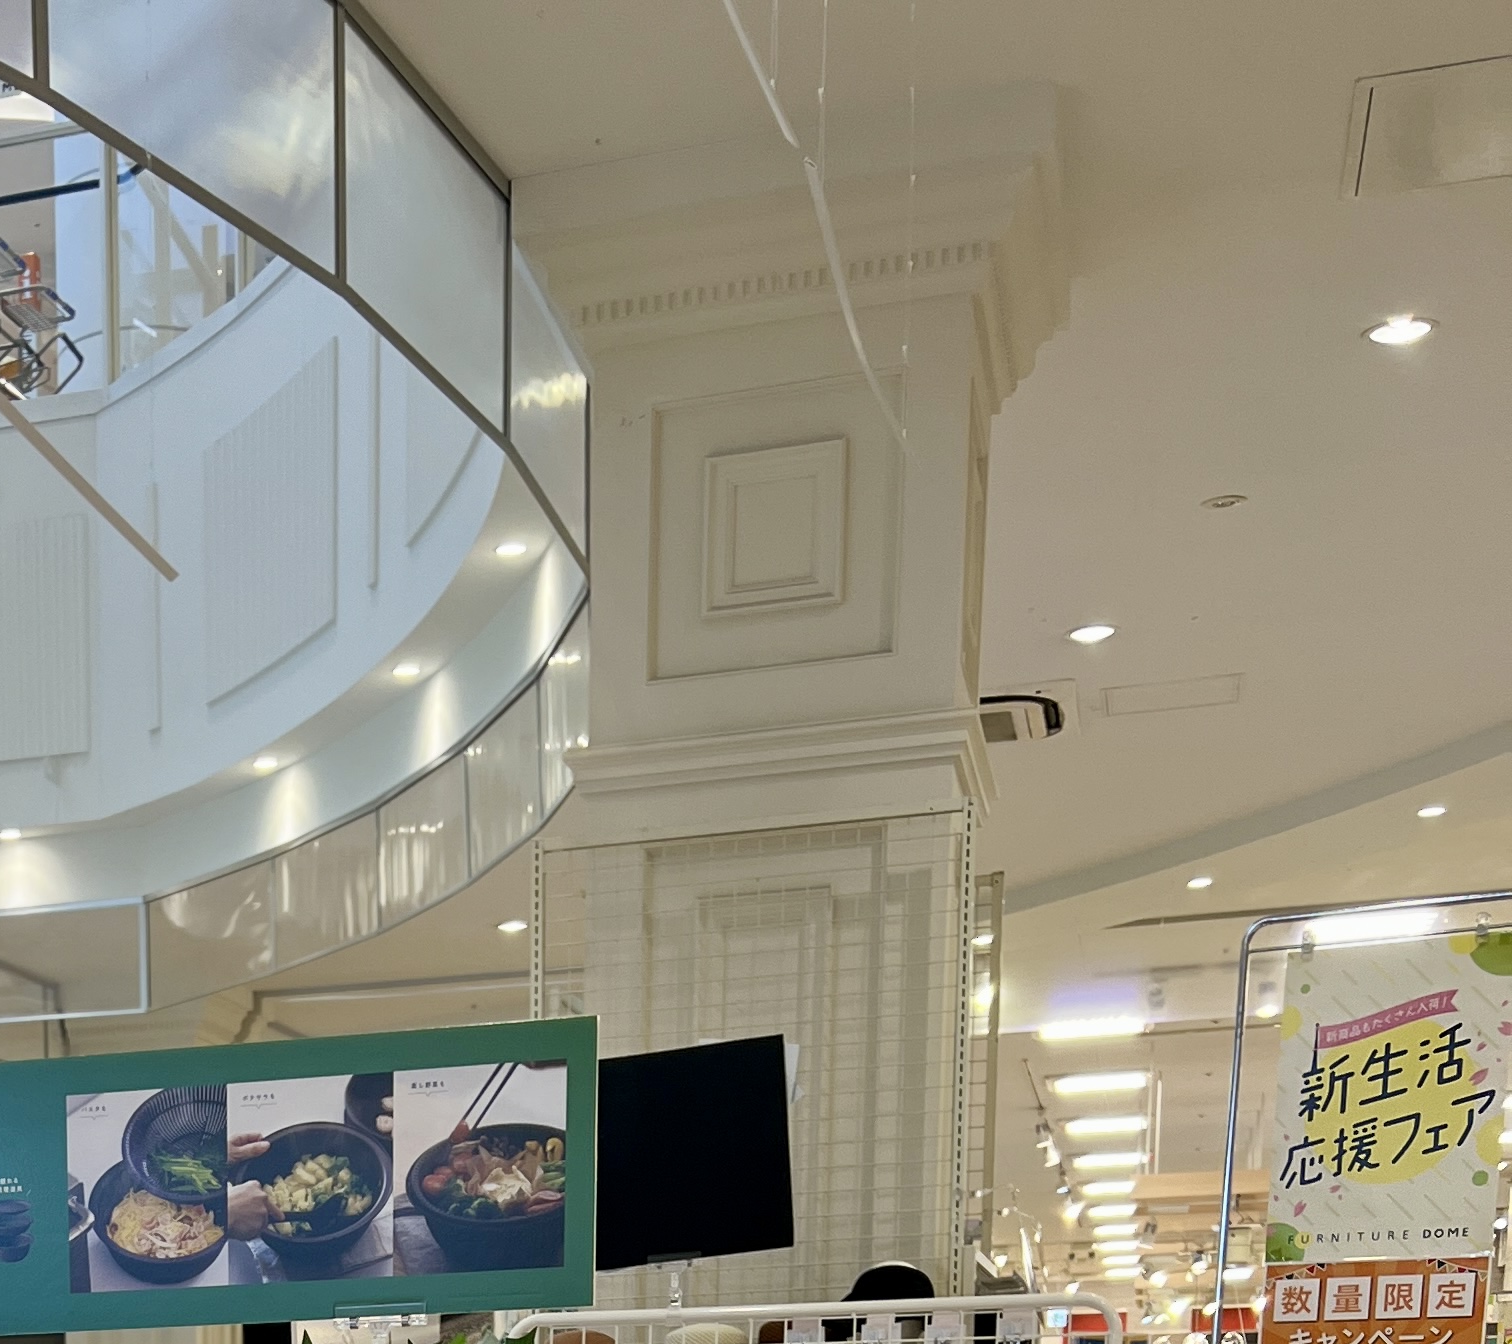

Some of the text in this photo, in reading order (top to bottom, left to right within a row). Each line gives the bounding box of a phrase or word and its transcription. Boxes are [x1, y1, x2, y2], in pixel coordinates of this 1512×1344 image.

[1298, 1023, 1472, 1122] 新生活
[1279, 1089, 1497, 1190] 応援フェア
[1288, 1227, 1470, 1245] FURNITURE DOME
[1280, 1280, 1467, 1316] 数量限定
